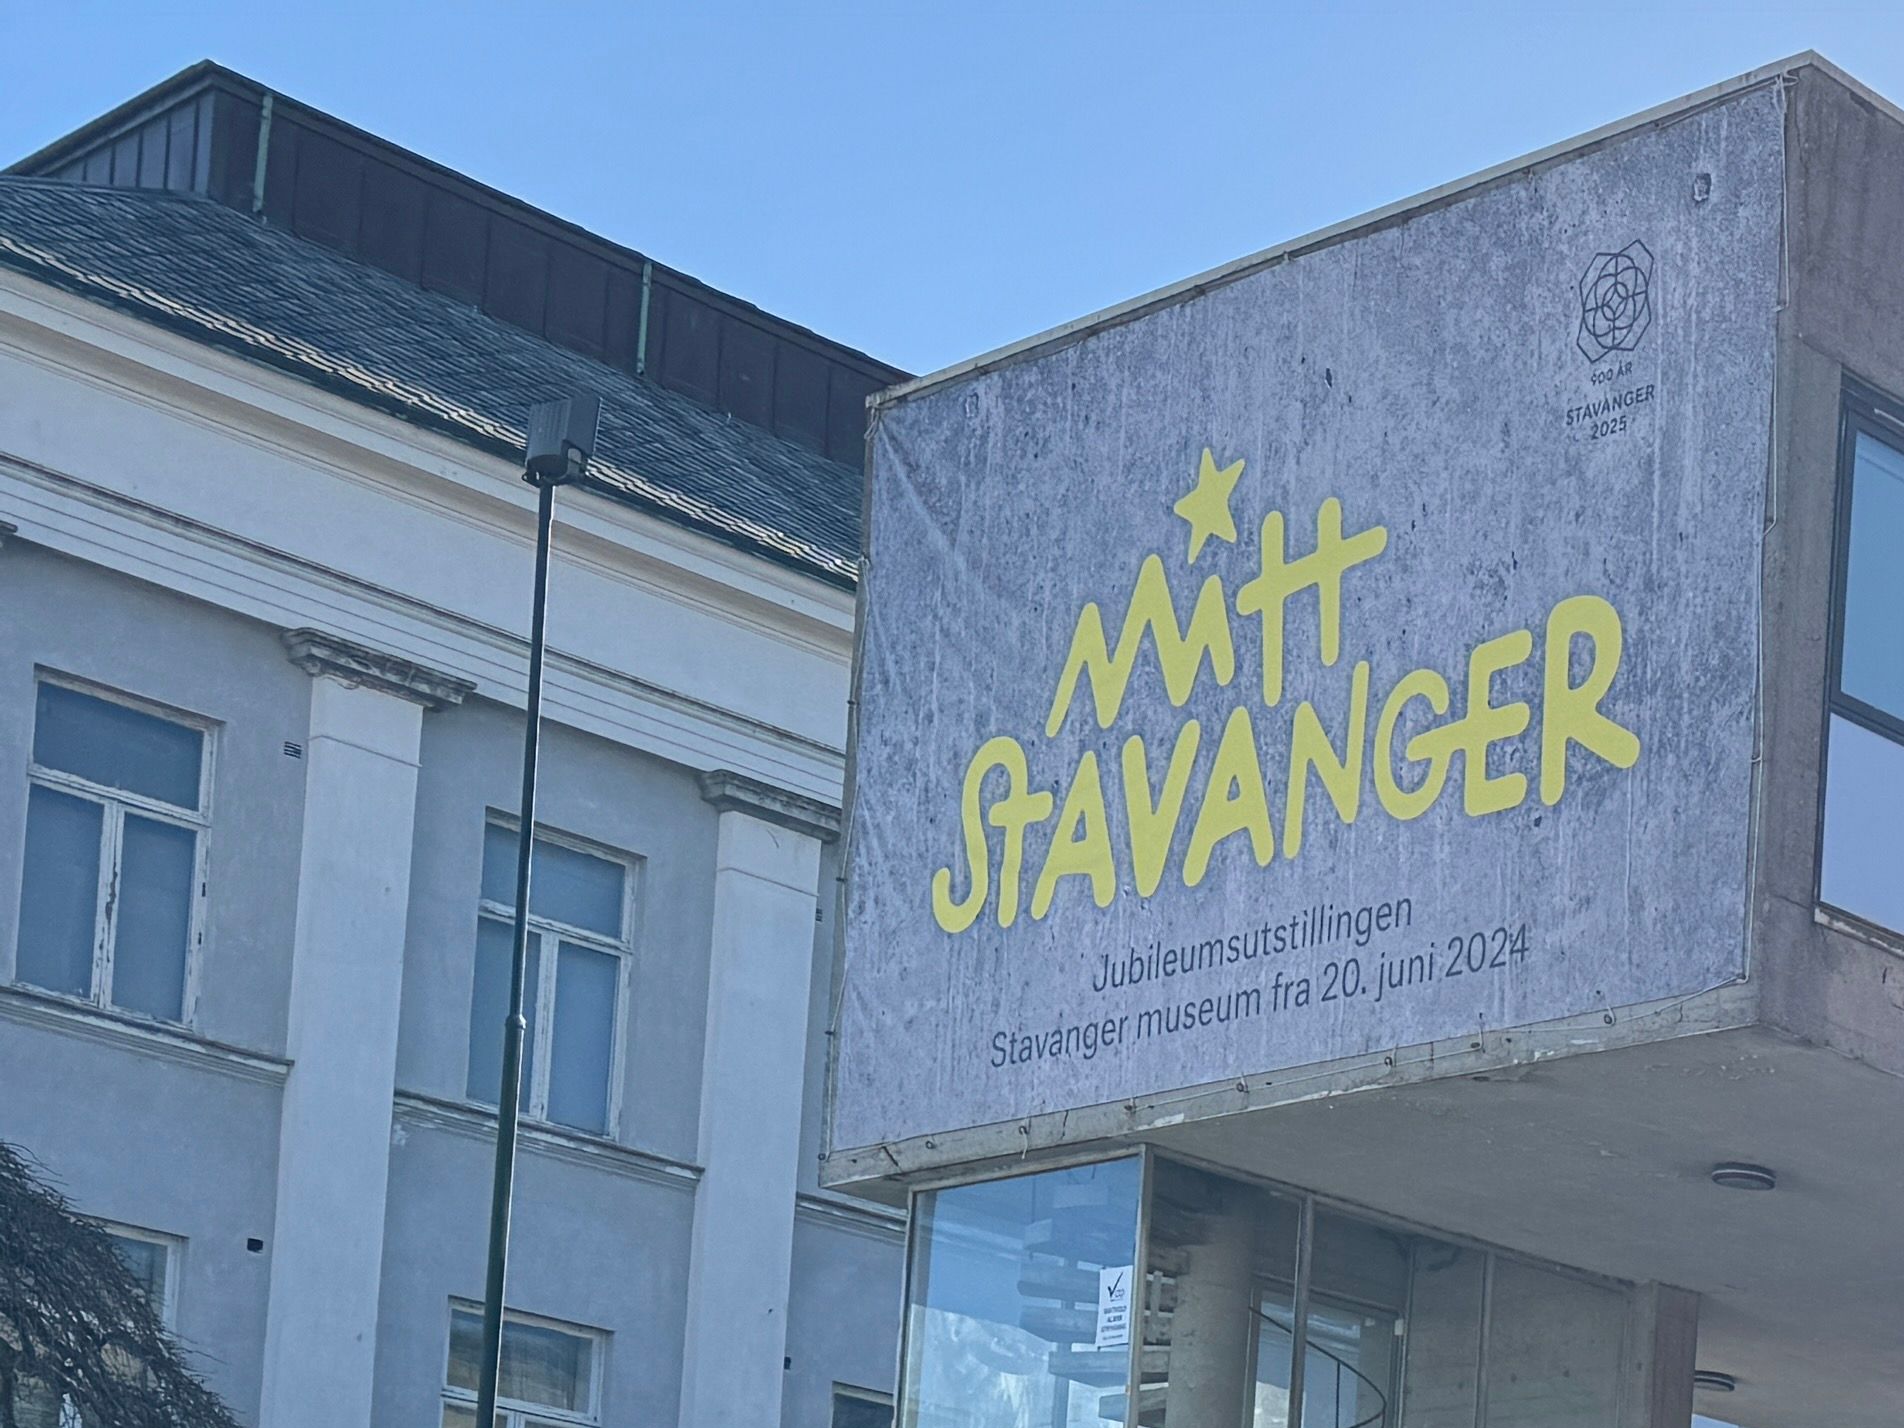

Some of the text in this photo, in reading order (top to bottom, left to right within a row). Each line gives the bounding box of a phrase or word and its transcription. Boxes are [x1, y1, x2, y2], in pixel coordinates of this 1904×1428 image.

[1565, 383, 1655, 426] STAVANGER
[1590, 415, 1628, 440] 2025
[1092, 897, 1413, 993] Jubileumsutstillingen
[990, 922, 1530, 1068] Stavanger museum fra 20. juni 2024
